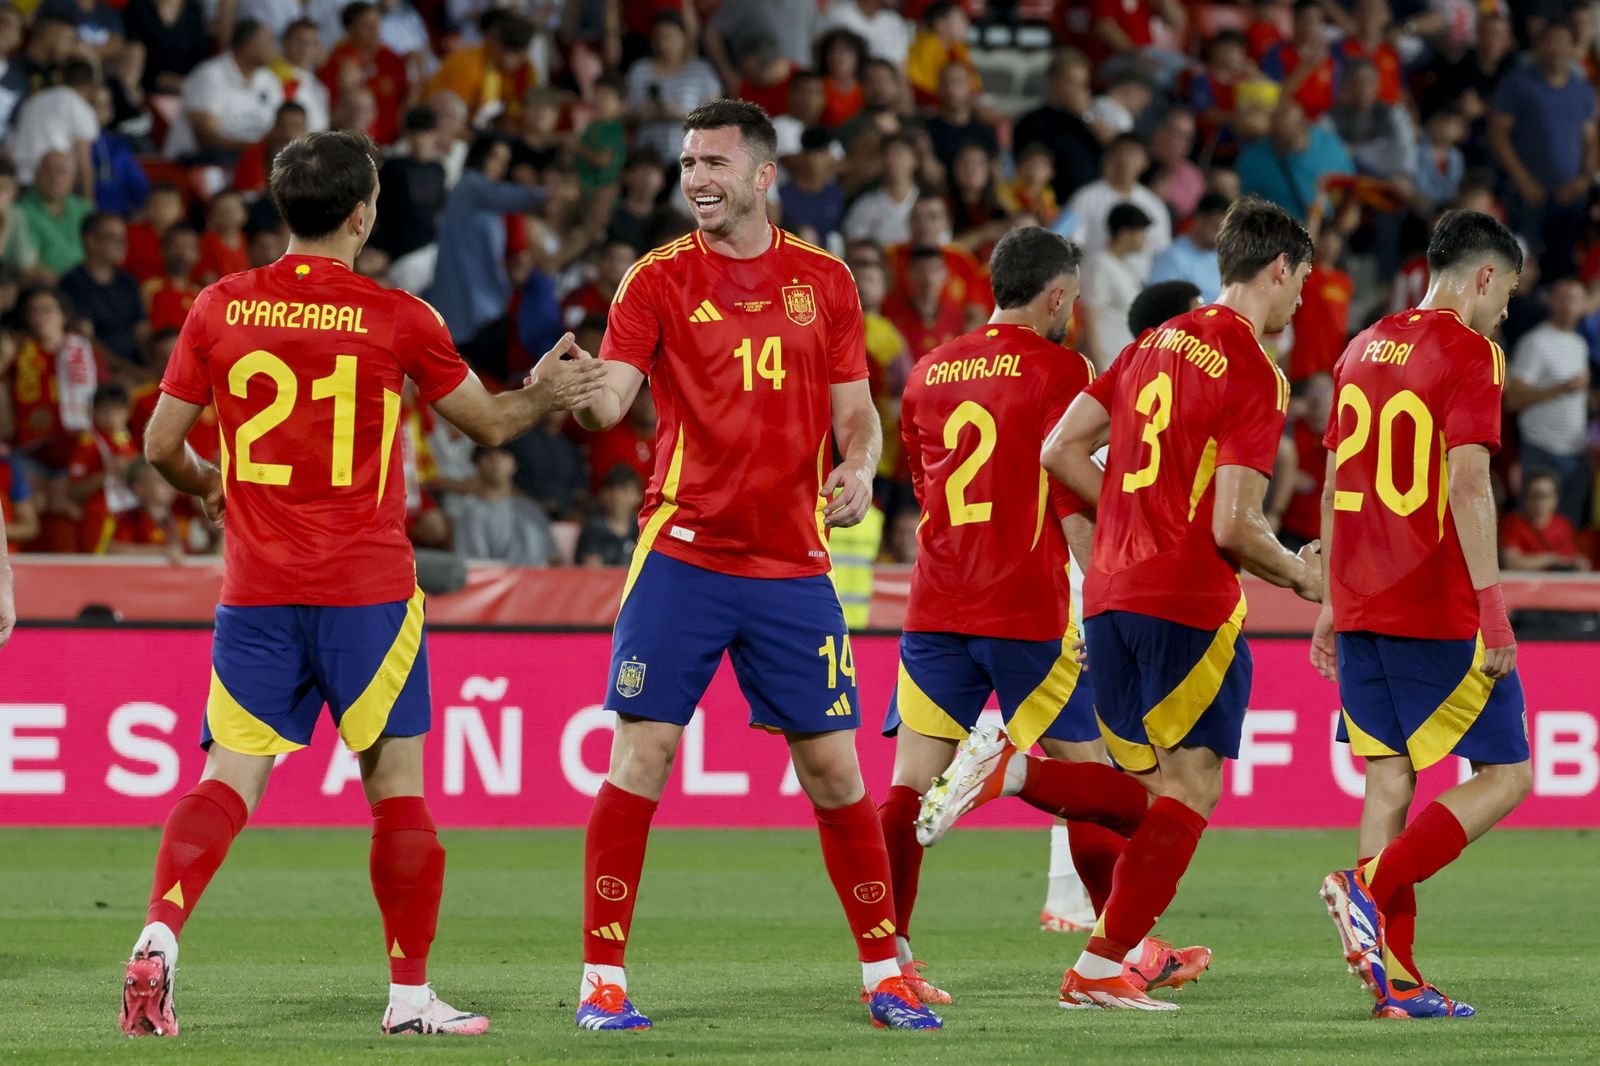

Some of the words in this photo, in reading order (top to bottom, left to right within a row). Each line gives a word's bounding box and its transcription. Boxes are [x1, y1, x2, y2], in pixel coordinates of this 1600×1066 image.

[226, 300, 368, 333] OYARZABAL
[733, 336, 786, 391] 14
[925, 354, 1022, 386] CARVAJAL
[1361, 340, 1414, 365] PEDRI
[228, 350, 358, 486] 21
[1122, 372, 1173, 493] 3
[943, 400, 997, 526] 2
[1334, 383, 1434, 517] 20
[818, 634, 857, 689] 14
